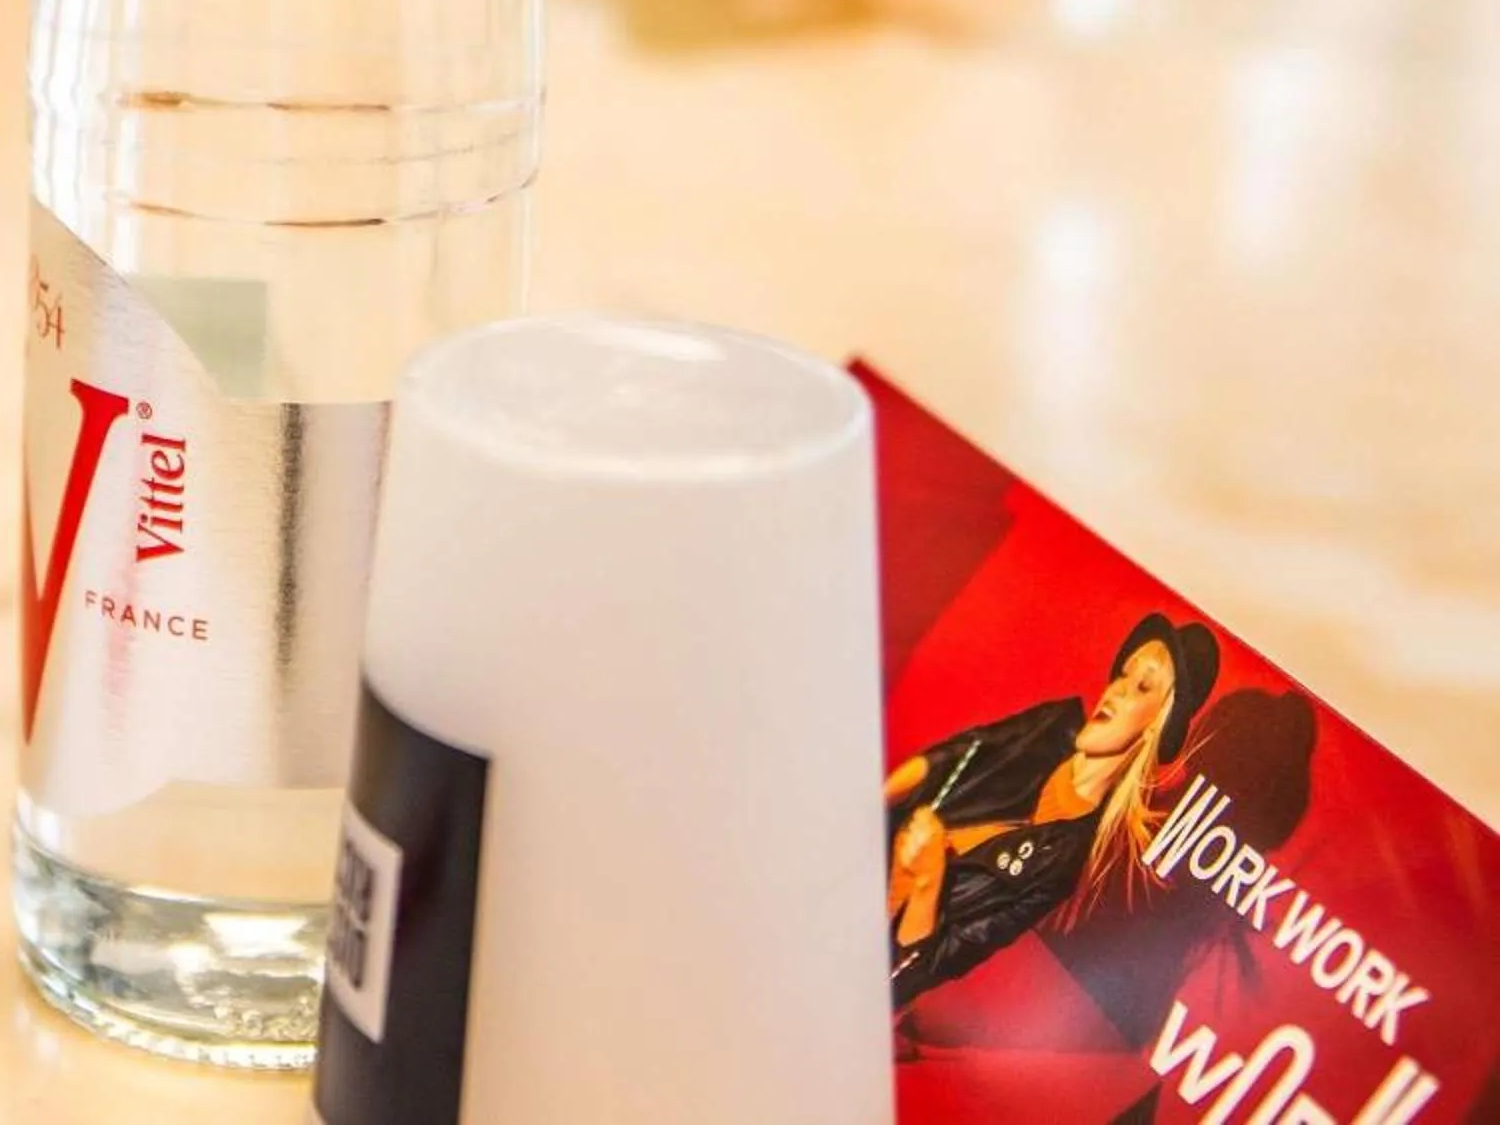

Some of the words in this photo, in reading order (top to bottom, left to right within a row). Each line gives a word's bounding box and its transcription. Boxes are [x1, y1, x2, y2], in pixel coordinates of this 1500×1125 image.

[84, 589, 209, 641] FRANCE
[1142, 774, 1297, 931] WORK
[1273, 889, 1430, 1047] WORK
